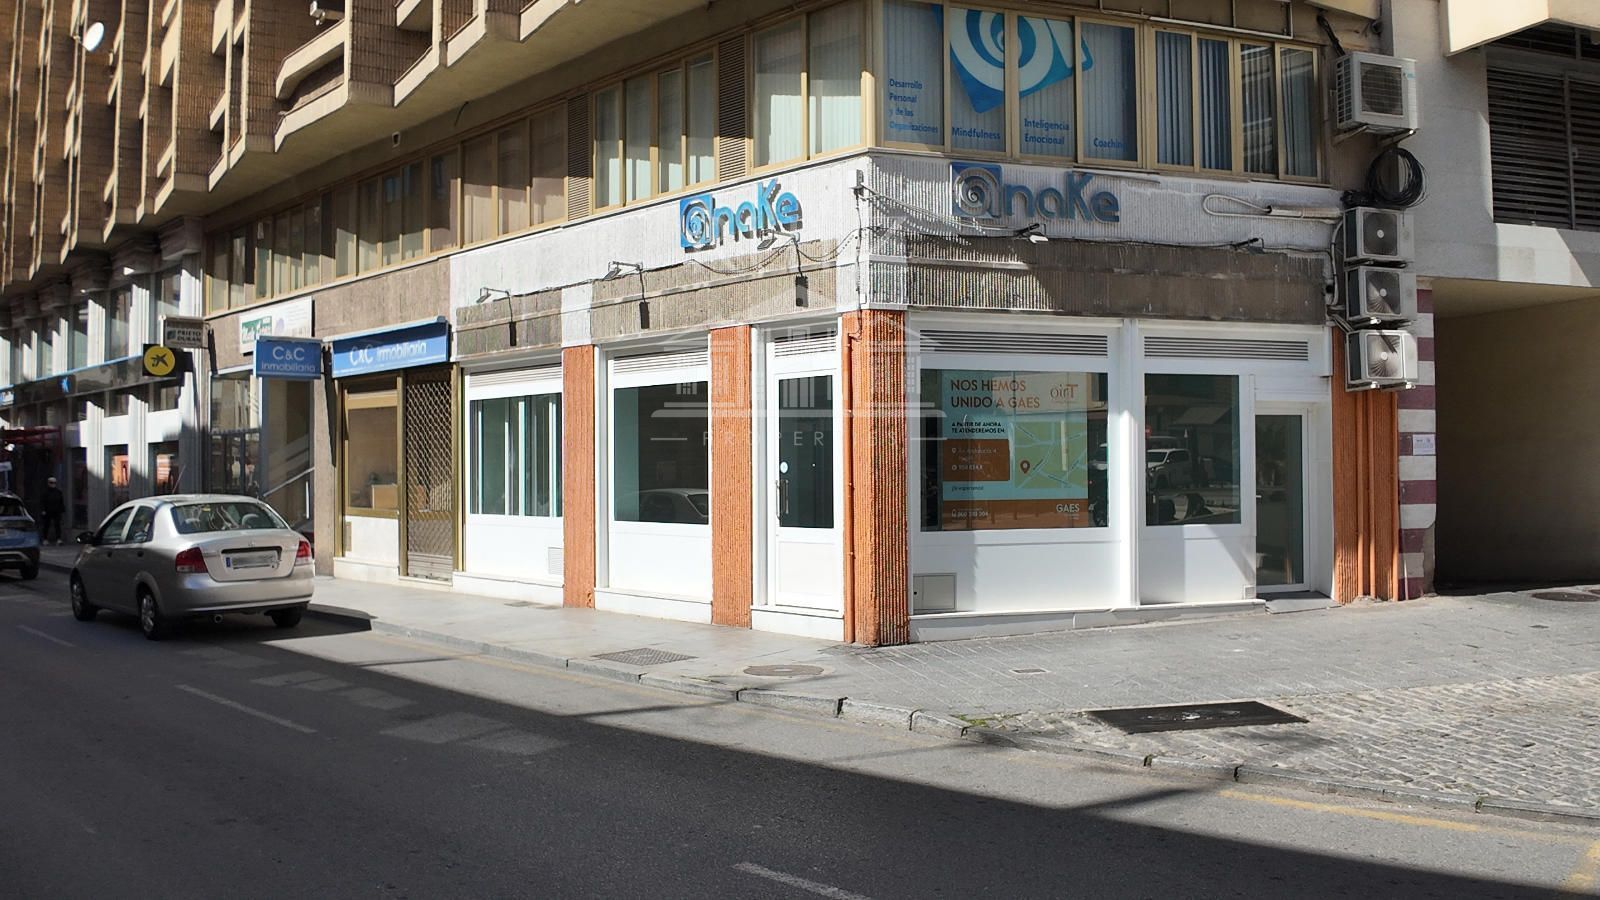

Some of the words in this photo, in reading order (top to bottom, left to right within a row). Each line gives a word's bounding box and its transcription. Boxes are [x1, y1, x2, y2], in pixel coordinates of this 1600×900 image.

[889, 78, 923, 90] Desarrollo
[889, 92, 918, 103] Personal
[895, 107, 904, 116] de
[904, 107, 914, 117] las
[1024, 118, 1070, 132] Inteligencia
[951, 126, 1001, 140] Mindfulness
[1024, 133, 1065, 145] Emocional
[272, 345, 306, 362] C&C
[350, 343, 375, 366] C&C
[951, 380, 978, 392] NOS
[981, 380, 1026, 392] HEMOS
[951, 396, 993, 409] UNIDO
[995, 396, 1005, 409] A
[1008, 396, 1041, 409] GAES
[1055, 503, 1080, 513] GAES
